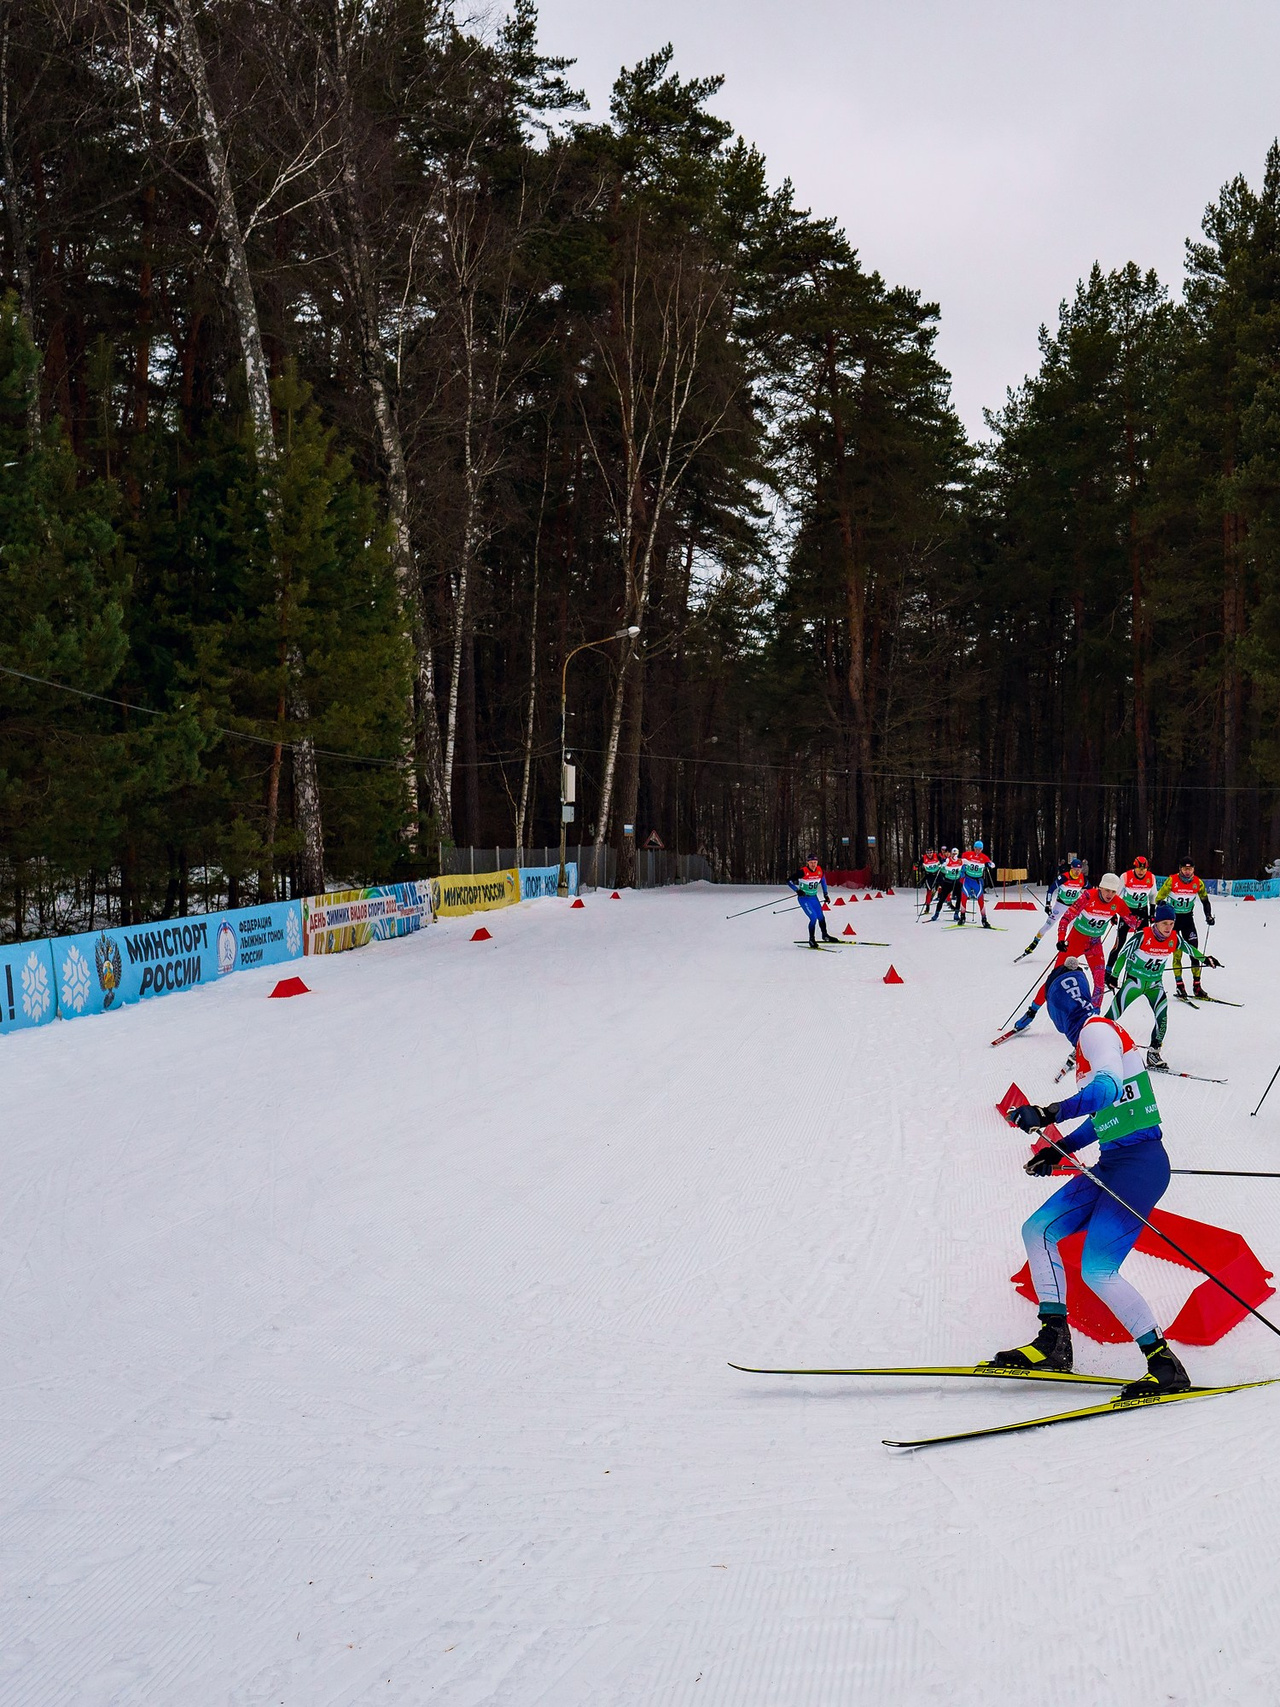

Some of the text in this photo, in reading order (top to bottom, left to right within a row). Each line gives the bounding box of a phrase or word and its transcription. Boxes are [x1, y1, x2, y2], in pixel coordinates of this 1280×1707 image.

[444, 882, 506, 907] МИНСПОРТ РОССИИ
[1065, 889, 1077, 898] 68
[1132, 892, 1147, 902] 42
[1177, 897, 1190, 908] 31
[309, 912, 326, 933] ДЕНЬ
[327, 907, 350, 926] ЗИМНИХ
[350, 904, 368, 922] ВИДОВ
[368, 901, 386, 917] СПОРТА
[386, 899, 397, 914] 2022
[1088, 918, 1105, 929] 49
[239, 916, 273, 933] ФЕДЕРАЦИЯ
[124, 922, 208, 965] МИНСПОРТ
[240, 929, 285, 949] ЛЫЖНЫХ ГОНОК
[241, 949, 264, 965] РОССИИ
[1144, 958, 1163, 972] 45
[139, 956, 202, 996] РОССИИ
[1155, 1016, 1167, 1041] RUSSIA
[1120, 1084, 1134, 1103] 28
[973, 1367, 1030, 1376] FISCHER
[1112, 1397, 1161, 1409] FISCHER
